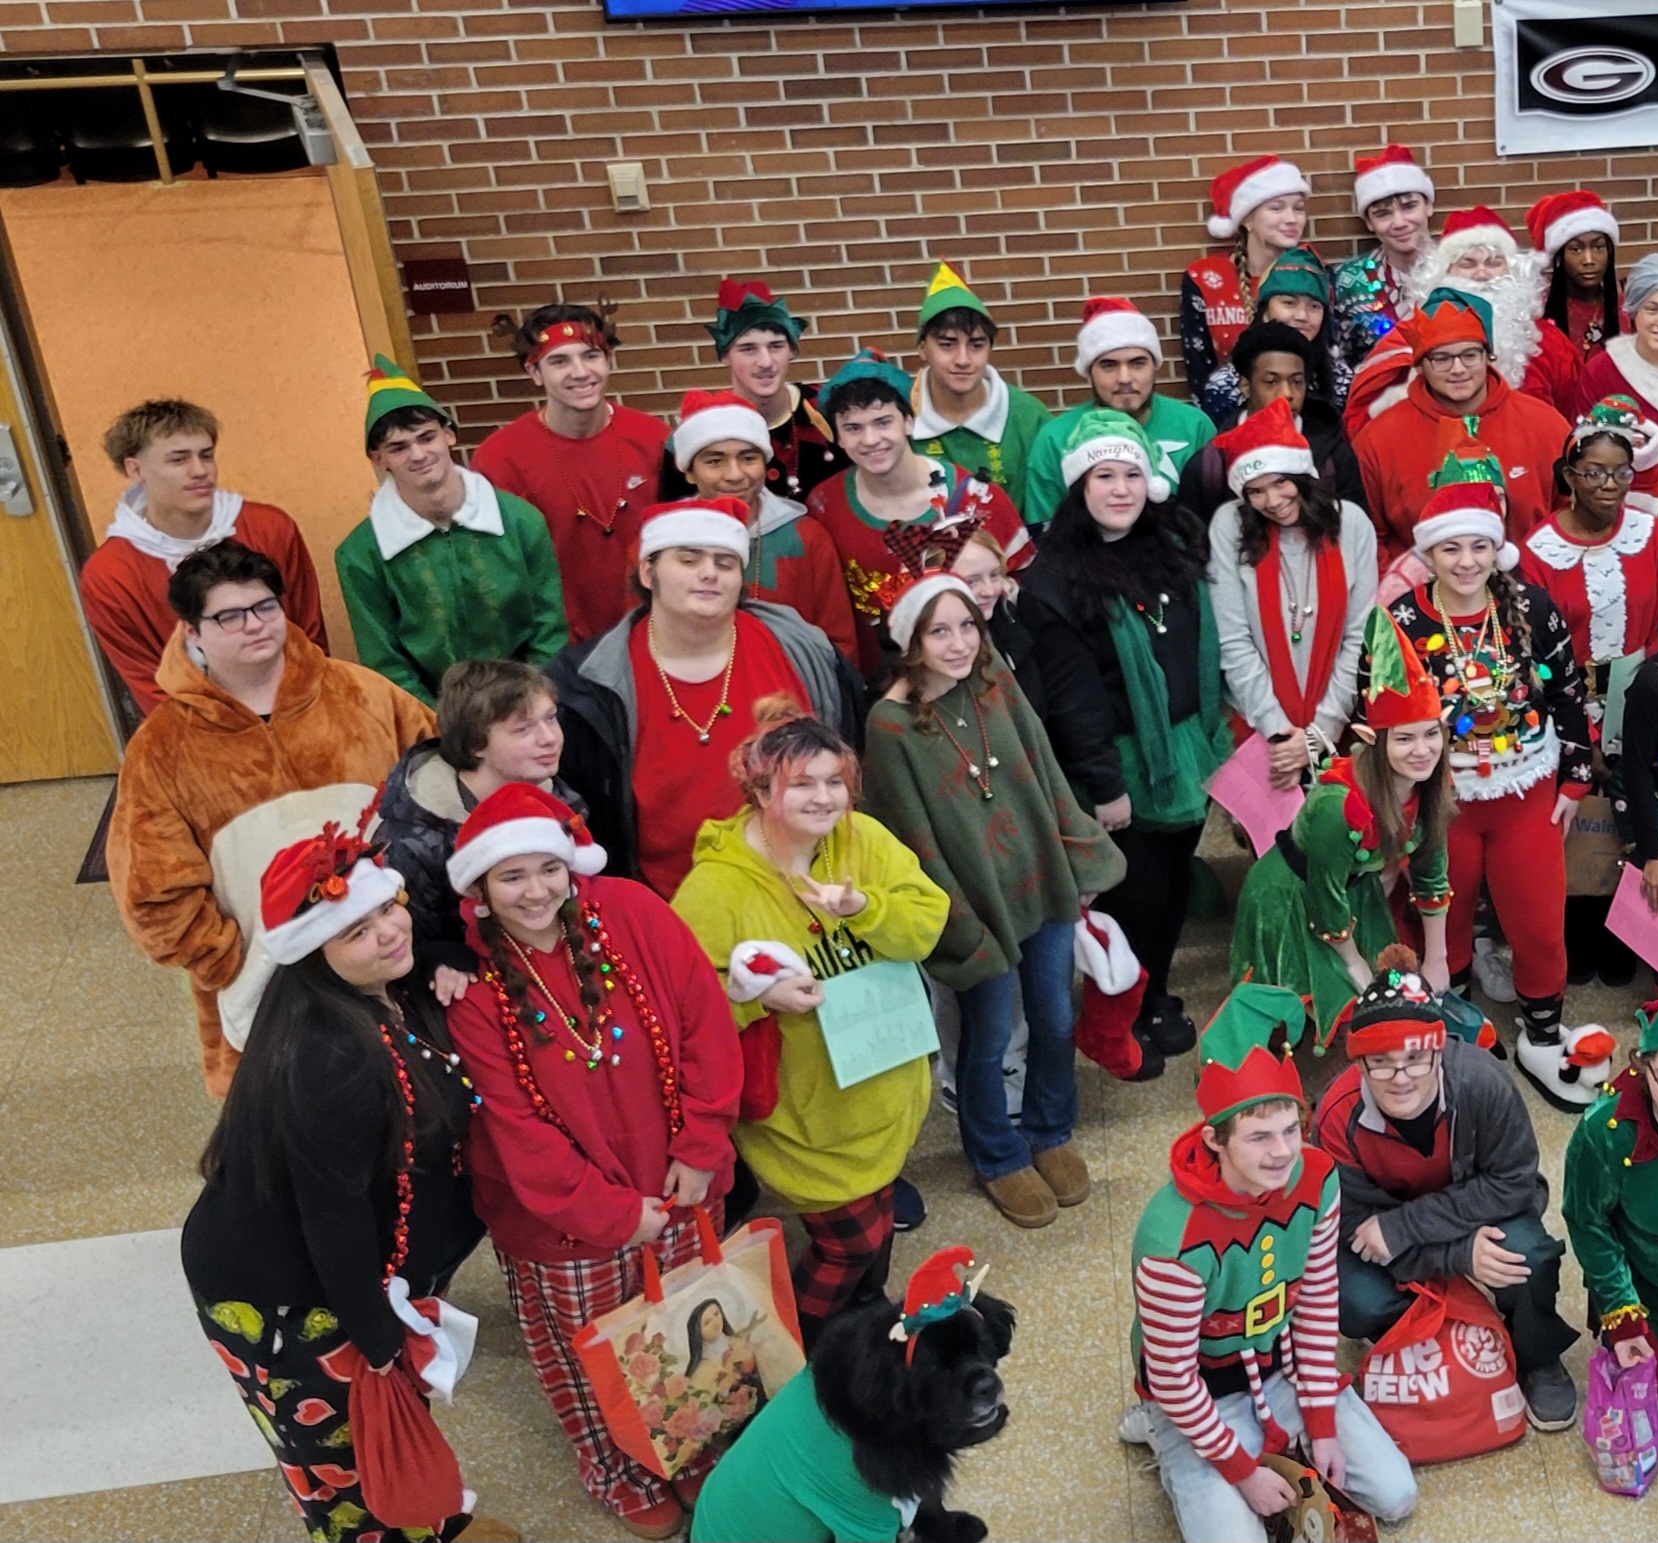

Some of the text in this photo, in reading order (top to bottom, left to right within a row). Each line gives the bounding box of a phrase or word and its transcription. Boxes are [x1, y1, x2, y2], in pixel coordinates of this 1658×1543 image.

[413, 280, 468, 291] AUDITORIUM
[1206, 306, 1250, 326] HANG
[1364, 1364, 1450, 1405] BELOW
